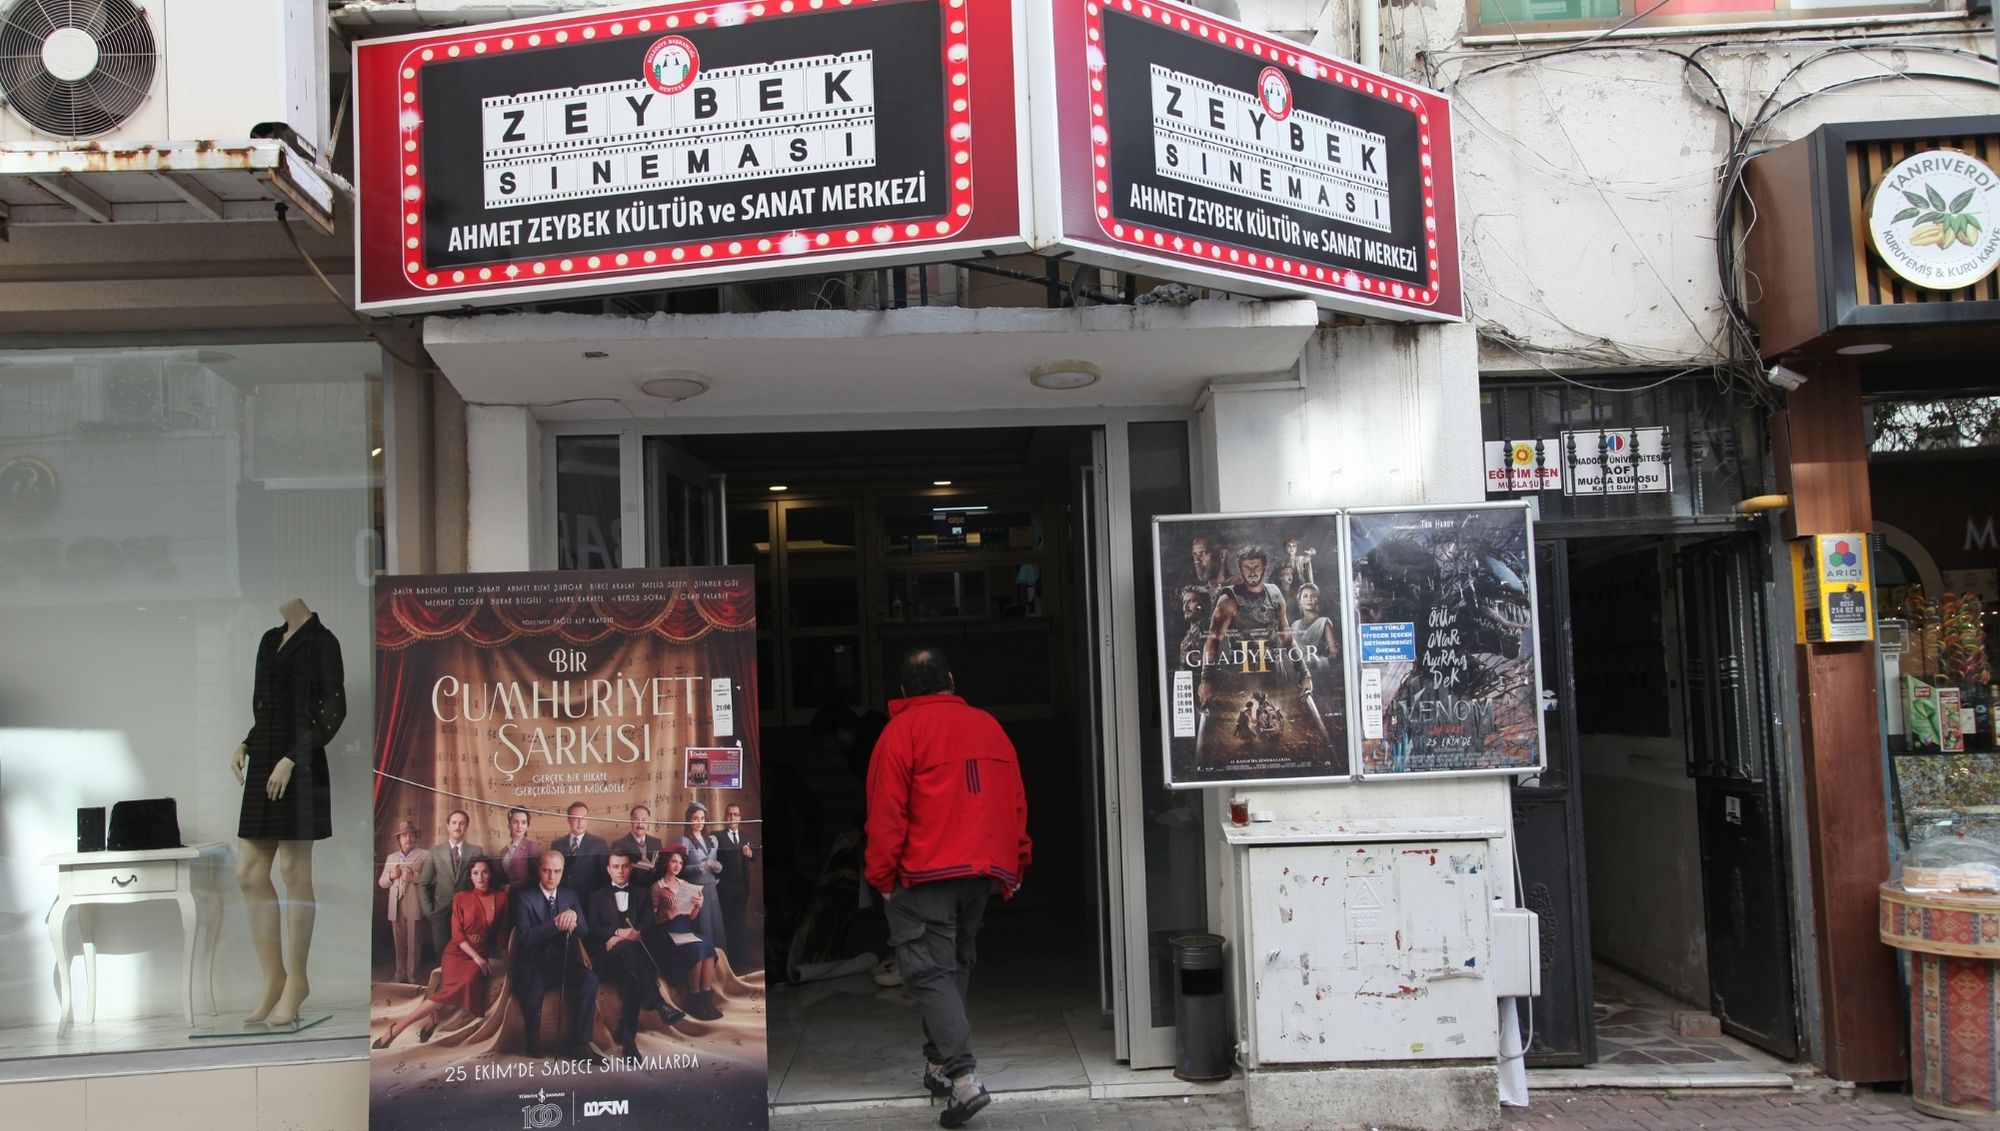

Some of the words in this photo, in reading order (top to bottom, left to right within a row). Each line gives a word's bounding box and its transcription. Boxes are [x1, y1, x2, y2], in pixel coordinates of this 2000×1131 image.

[503, 70, 853, 143] ZEYBEK
[1166, 84, 1377, 174] ZEYBEK
[1888, 157, 2000, 192] TANRIVERDİ
[448, 219, 523, 253] AHMET
[528, 211, 610, 245] ZEYBEK
[615, 198, 703, 236] KÜLTÜR
[707, 203, 735, 223] ve
[741, 187, 815, 222] SANAT
[821, 169, 926, 213] MERKEZİ
[1130, 183, 1185, 220] AHMET
[1188, 196, 1244, 233] ZEYBEK
[1247, 206, 1300, 246] KÜLTÜR
[1303, 233, 1319, 250] ve
[1321, 230, 1361, 260] SANAT
[1364, 239, 1418, 273] MERKEZİ
[1883, 230, 1932, 278] KURUYEMİŞ
[1936, 268, 1944, 278] &
[1948, 260, 1978, 278] KURU
[1976, 227, 2000, 264] KAHVE
[1488, 468, 1530, 480] EĞTİM
[1534, 468, 1558, 478] SEN
[1529, 480, 1551, 488] ŞUE
[1578, 476, 1614, 486] MUĞA
[1604, 464, 1630, 475] AÖF
[1826, 569, 1862, 577] ARICI
[548, 648, 588, 674] BİR
[432, 672, 704, 722] CUMHURİYET
[1398, 688, 1493, 722] VENOM
[494, 723, 652, 781] ŞARKISI
[532, 774, 564, 784] GERÇEK
[567, 773, 580, 782] BİR
[570, 784, 582, 794] BİR
[444, 1066, 468, 1082] 25
[475, 1062, 534, 1080] EKİM'DE
[542, 1058, 593, 1076] SADECE
[600, 1054, 700, 1074] SİNEMALARDA
[521, 1103, 563, 1129] 100
[584, 1100, 629, 1117] BKM
